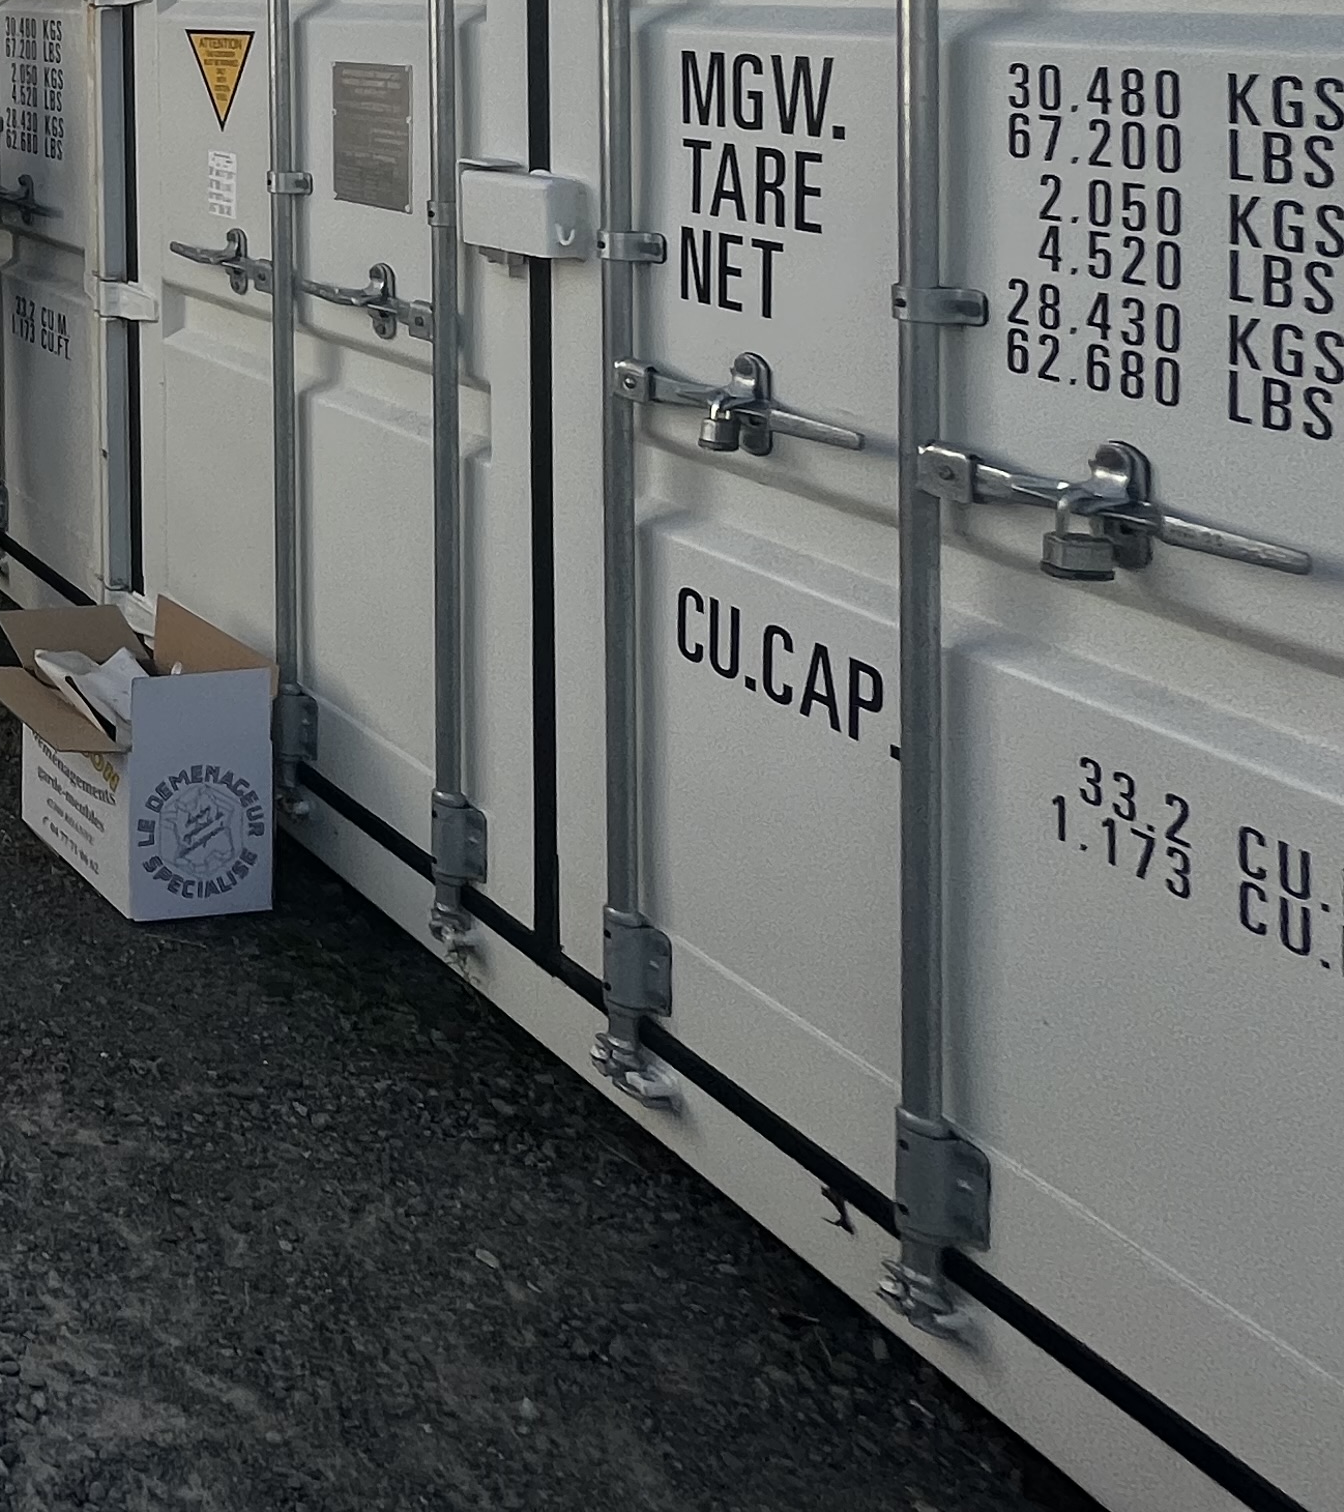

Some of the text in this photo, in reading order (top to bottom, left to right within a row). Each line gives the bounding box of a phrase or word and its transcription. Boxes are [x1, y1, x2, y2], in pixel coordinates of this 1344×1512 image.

[42, 19, 62, 42] KGS
[43, 41, 62, 64] LBS
[43, 66, 64, 90] KGS
[44, 89, 63, 112] LBS
[680, 49, 1344, 141] MGW. 30.480 KGS
[44, 114, 64, 139] KGS
[44, 137, 64, 161] LBS
[1007, 113, 1335, 189] 67.200 LBS
[681, 138, 1344, 259] TARE 2.050 KGS
[679, 225, 1344, 386] NET 28.430 KGS
[1038, 225, 1335, 316] 4.520 LBS
[1006, 328, 1335, 441] 62.680 LBS
[676, 586, 901, 763] CU.CAP.
[137, 818, 156, 848] LE
[144, 764, 266, 837] DEMENAGEUR
[1078, 756, 1344, 913] 33.2 CU.
[142, 847, 258, 900] SPECIALISE
[1051, 794, 1344, 970] 1.173 CU.
